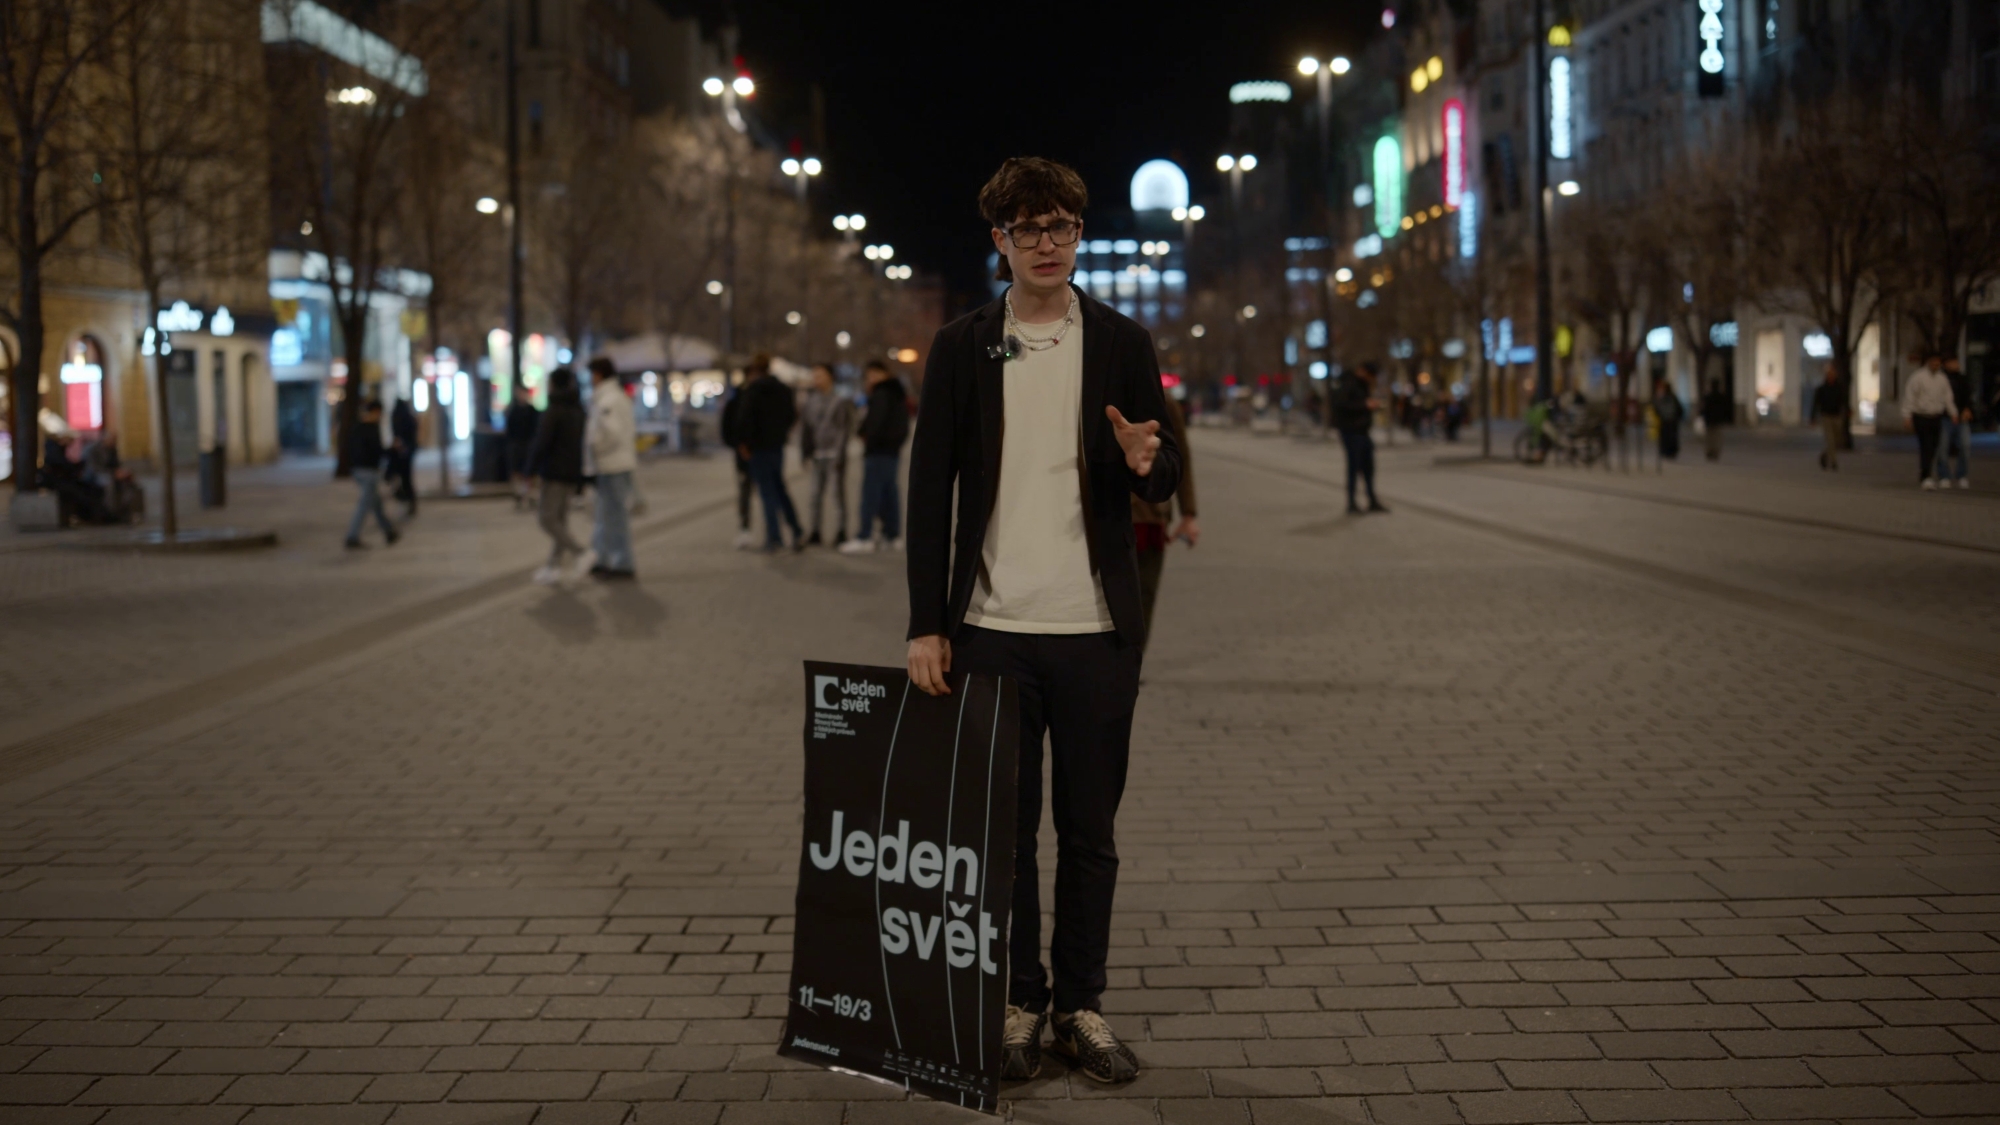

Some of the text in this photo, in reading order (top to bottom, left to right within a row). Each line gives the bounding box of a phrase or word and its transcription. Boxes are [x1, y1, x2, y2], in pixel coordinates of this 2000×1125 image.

[841, 677, 886, 698] Jeden
[841, 696, 871, 714] svět
[809, 810, 979, 897] Jeden
[881, 901, 998, 975] svět
